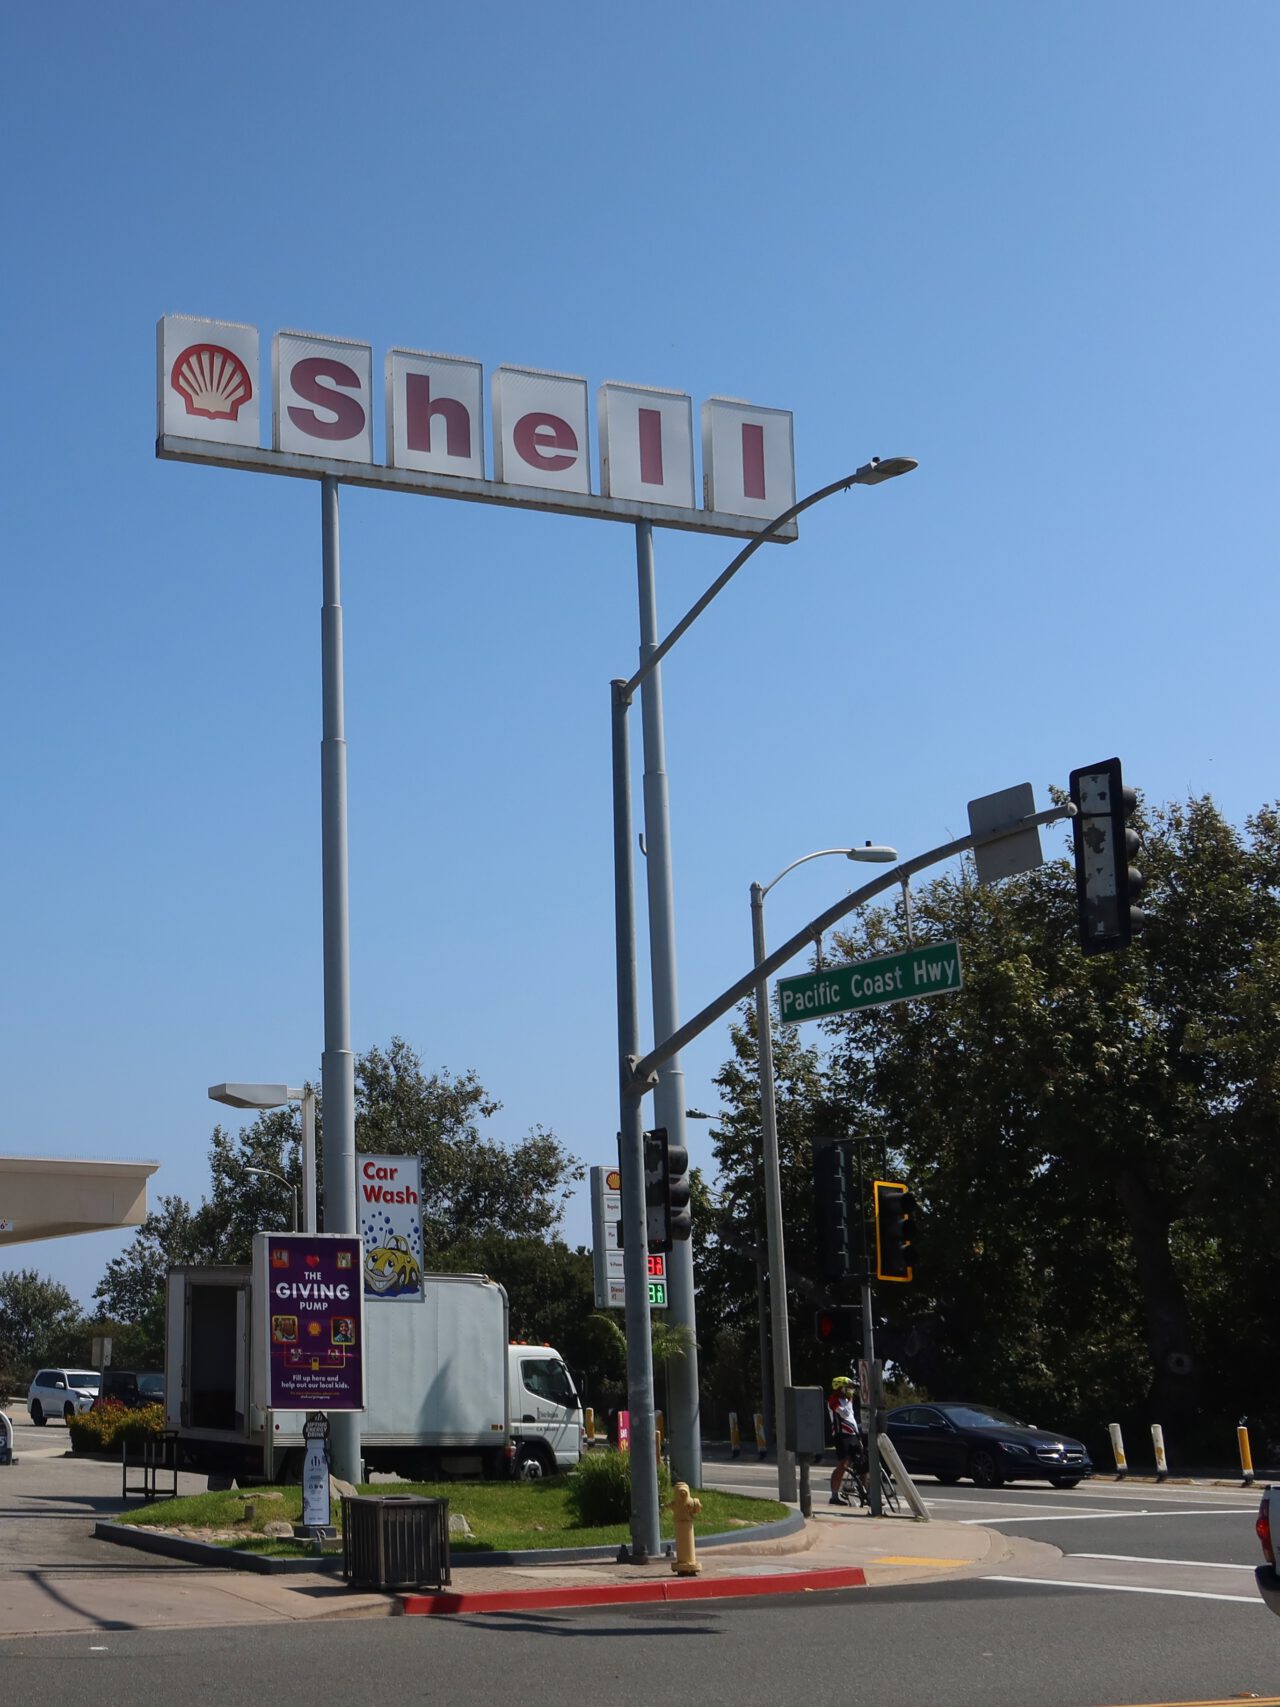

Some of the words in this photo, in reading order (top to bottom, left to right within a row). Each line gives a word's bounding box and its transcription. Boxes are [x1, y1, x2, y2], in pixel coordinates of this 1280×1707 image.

[285, 356, 766, 501] Shell
[782, 981, 840, 1013] Pacific
[851, 966, 903, 998] Coast
[913, 959, 955, 985] Hwy
[362, 1161, 399, 1181] Car
[362, 1184, 418, 1205] Wash
[304, 1271, 322, 1280] THE
[275, 1282, 350, 1300] GIVING
[299, 1301, 328, 1311] PUMP
[281, 1380, 295, 1389] help
[292, 1374, 302, 1382] Fill
[312, 1374, 326, 1382] here
